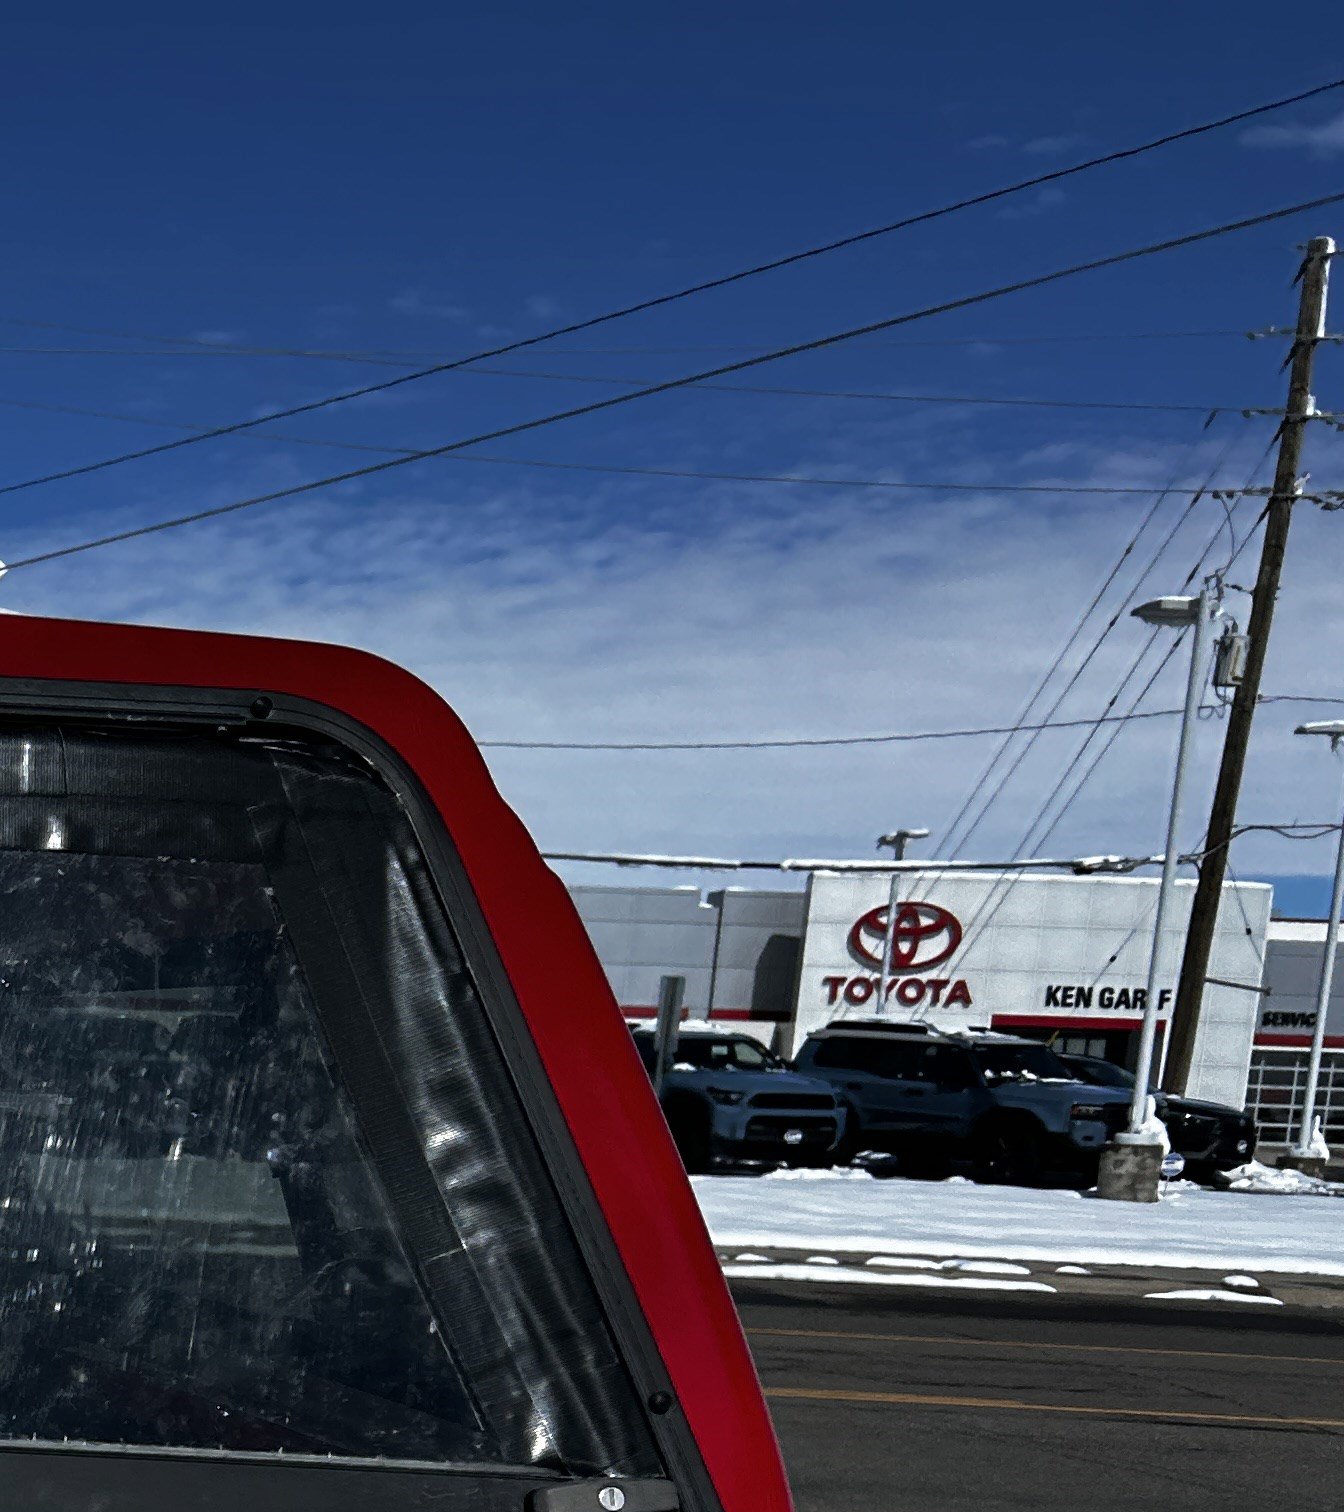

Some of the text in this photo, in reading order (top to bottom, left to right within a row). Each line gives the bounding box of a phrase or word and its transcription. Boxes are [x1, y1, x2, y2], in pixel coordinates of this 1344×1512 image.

[822, 976, 973, 1008] TOYOTA
[1045, 985, 1173, 1011] KEN GARF
[1261, 1010, 1317, 1028] SERVIC
